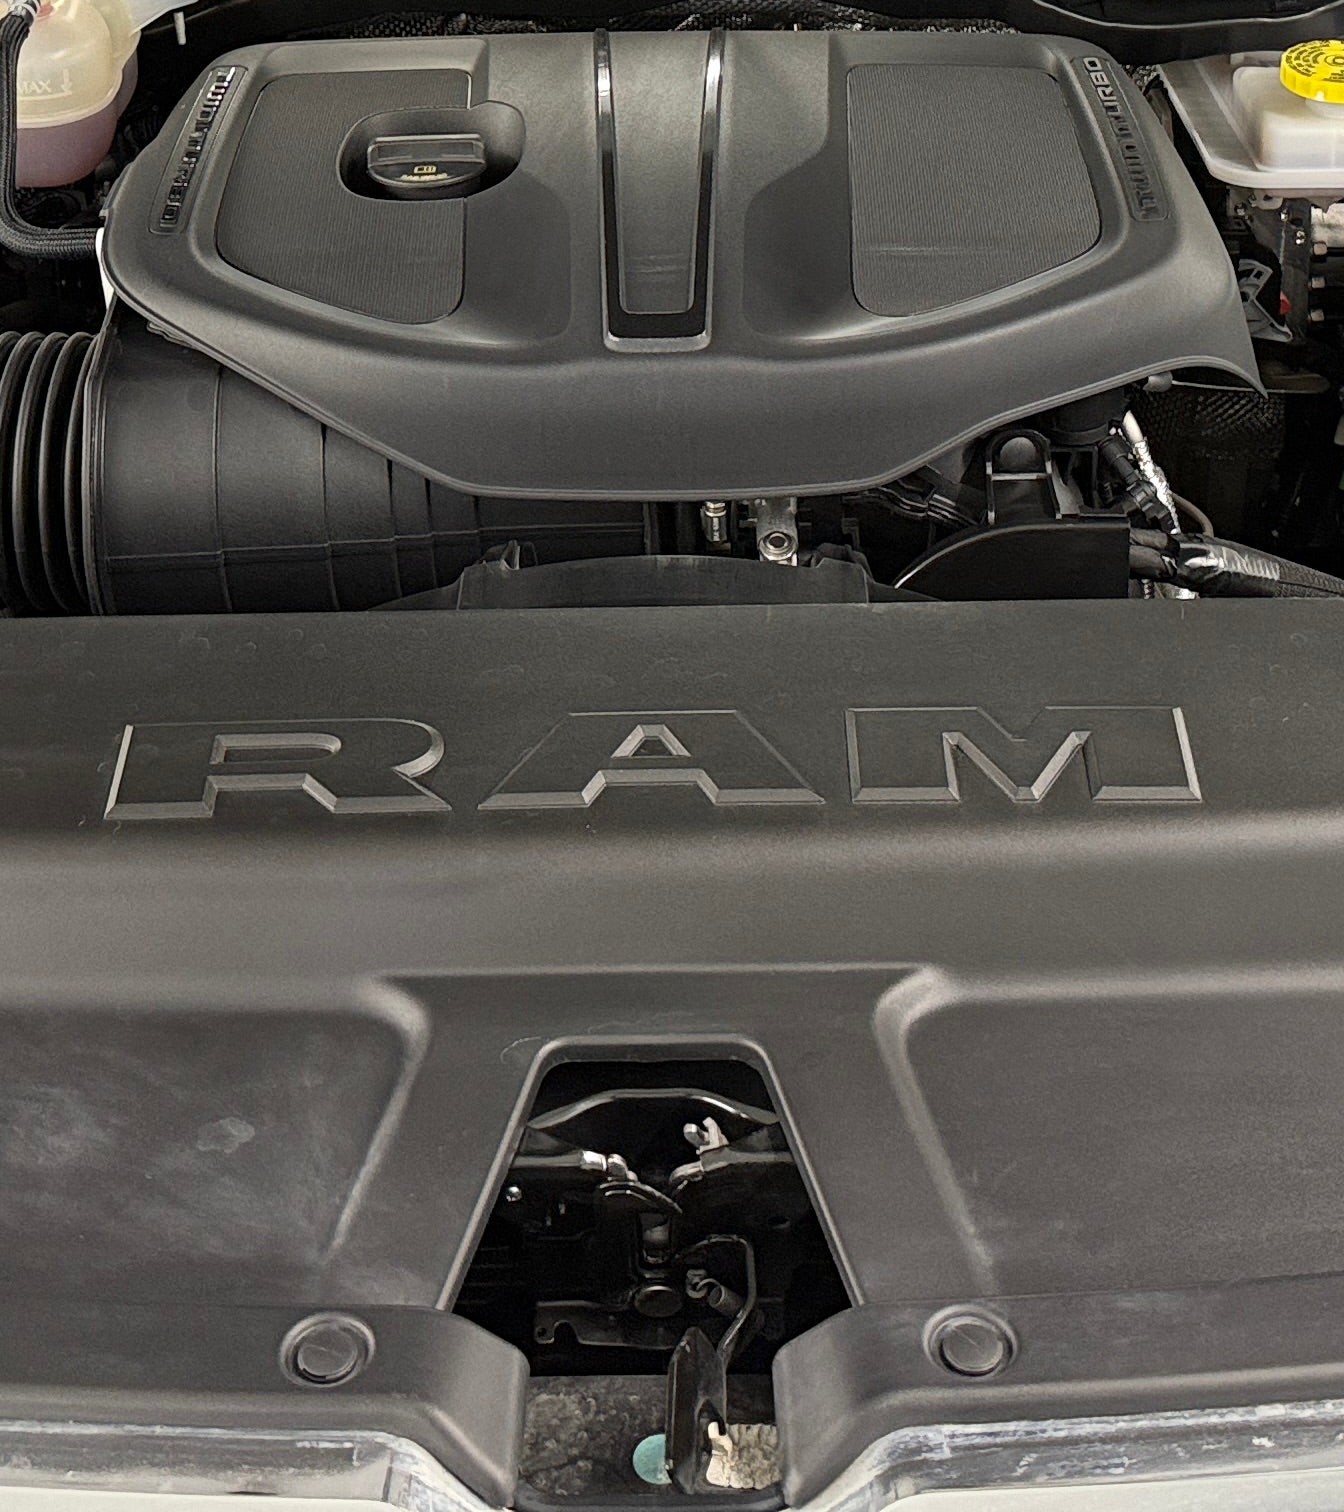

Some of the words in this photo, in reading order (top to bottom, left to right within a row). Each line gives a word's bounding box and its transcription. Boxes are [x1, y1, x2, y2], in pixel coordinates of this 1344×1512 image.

[1083, 57, 1132, 136] TURBO
[159, 124, 208, 228] TURBO
[104, 705, 1204, 820] RAM
